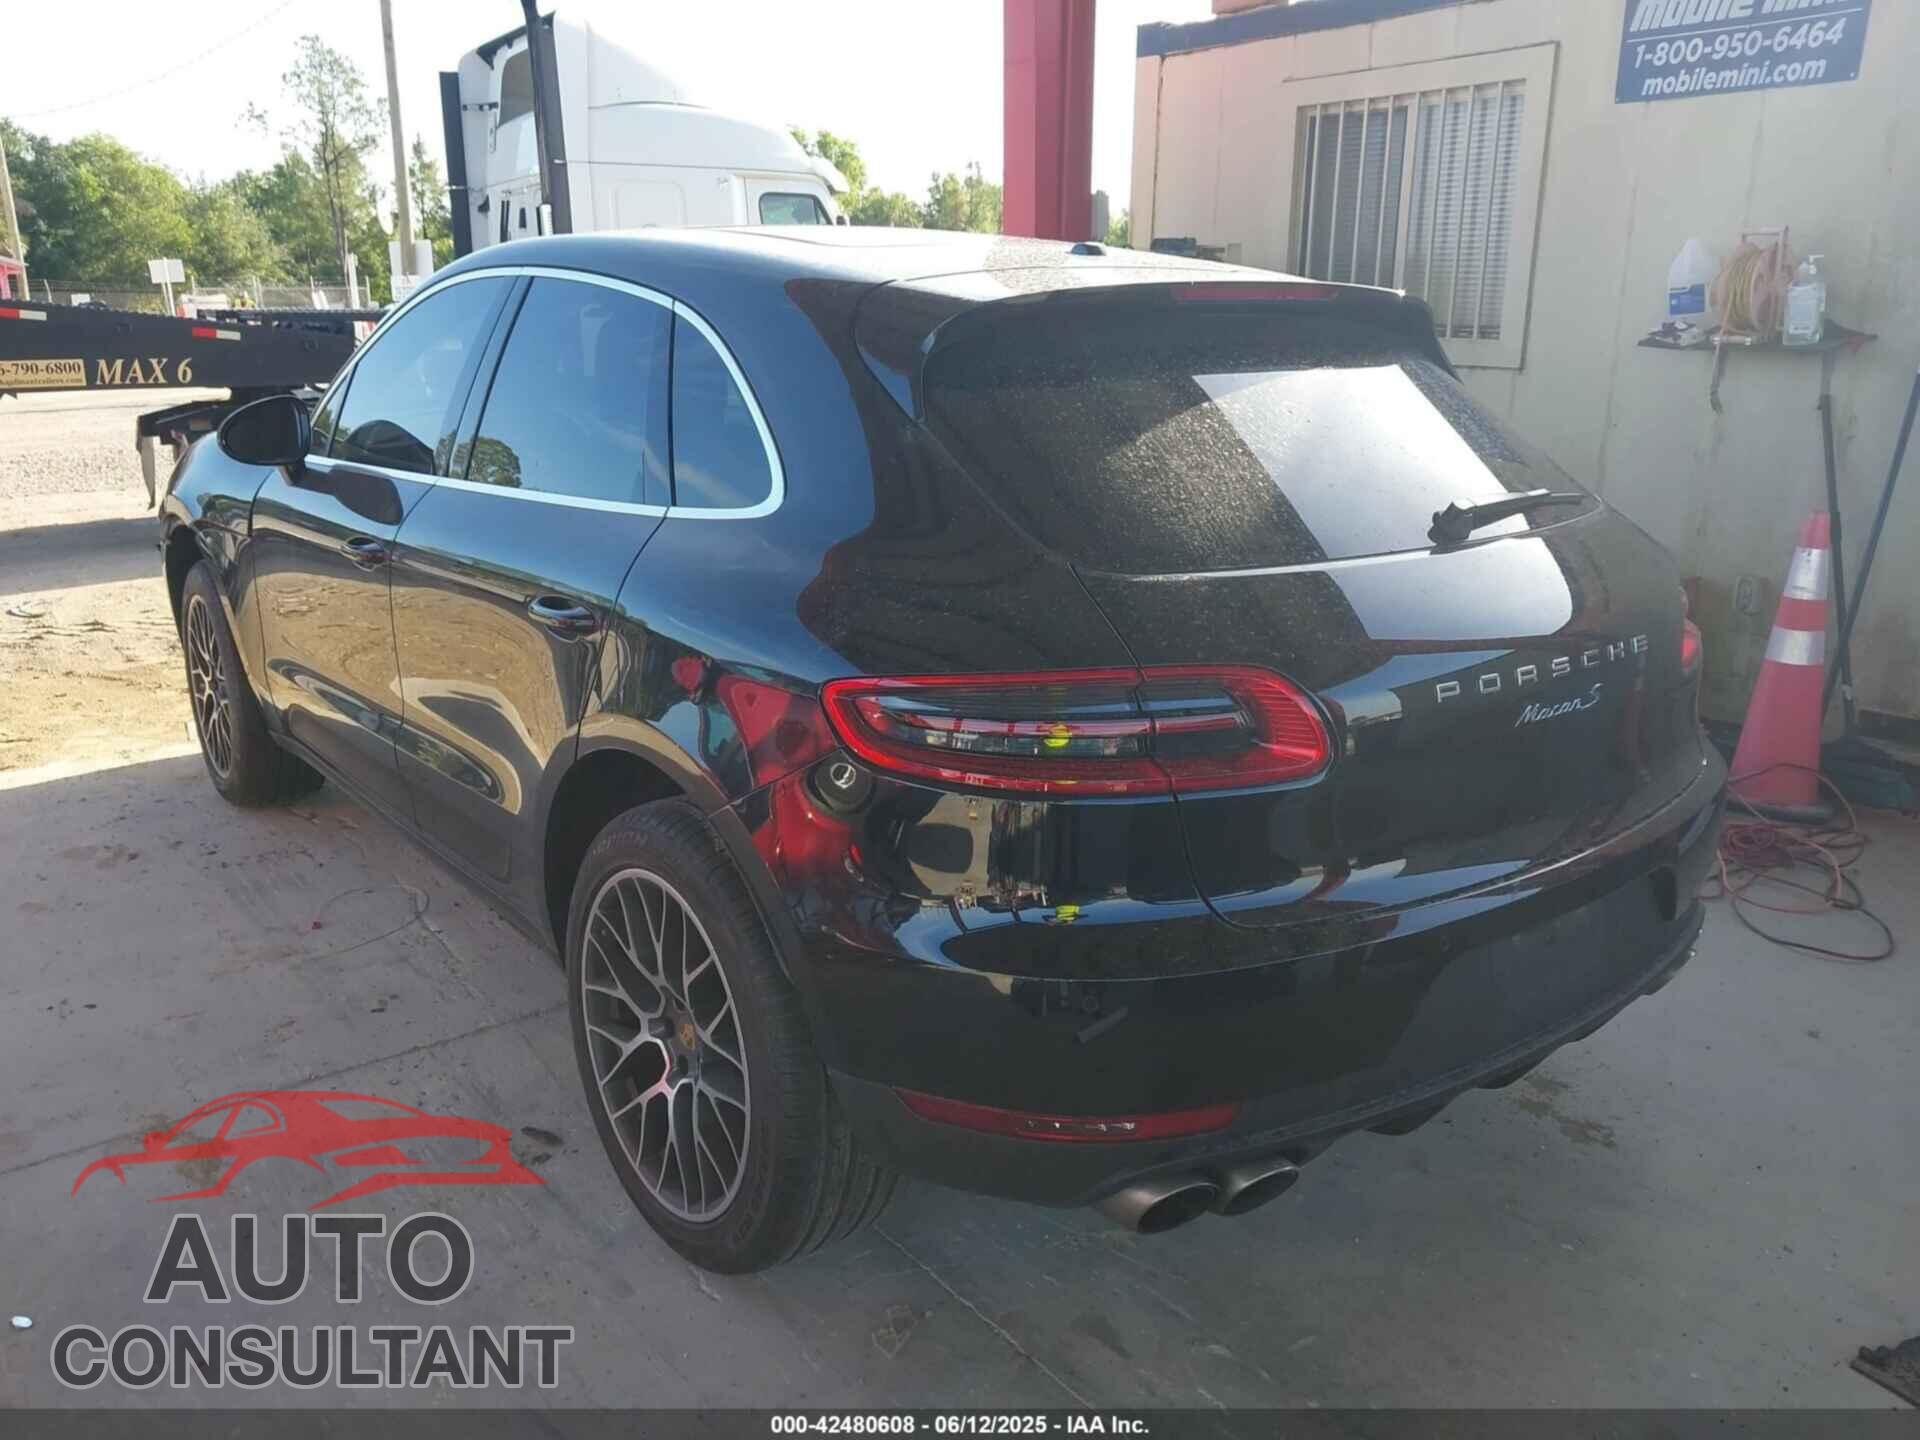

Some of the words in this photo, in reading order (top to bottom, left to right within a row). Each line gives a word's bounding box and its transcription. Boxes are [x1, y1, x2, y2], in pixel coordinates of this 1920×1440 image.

[1634, 17, 1847, 69] 1-800-950-6464
[1641, 59, 1827, 96] mobilemini.com
[96, 357, 169, 385] MAX
[177, 357, 193, 384] 6
[1435, 634, 1649, 703] PORSCHE
[1513, 697, 1583, 728] Macan
